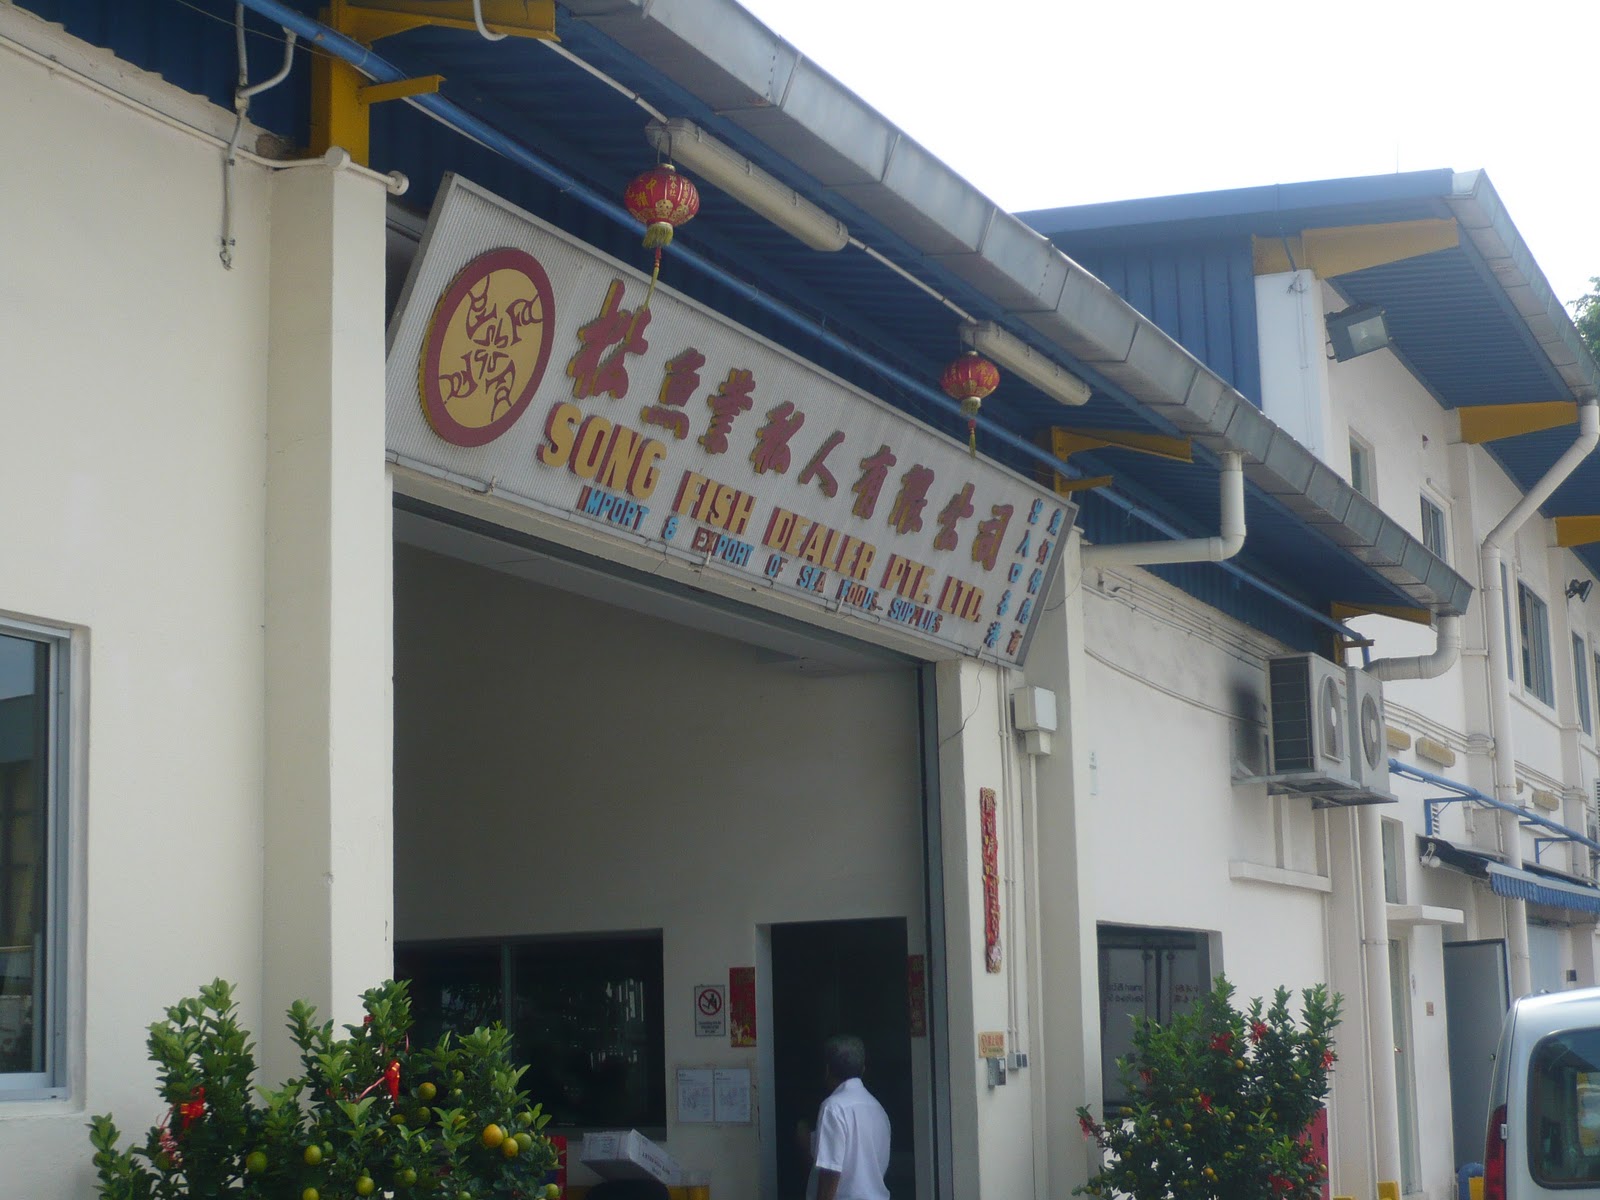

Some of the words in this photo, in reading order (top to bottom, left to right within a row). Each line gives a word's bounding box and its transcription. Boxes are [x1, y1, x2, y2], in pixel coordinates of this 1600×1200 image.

[536, 401, 667, 499] SONG
[672, 470, 757, 536] FISH
[762, 507, 876, 581] DEALER
[881, 553, 935, 604] PTE.
[937, 576, 985, 623] LTD.
[576, 485, 649, 531] IMPORT
[661, 515, 679, 541] &
[691, 526, 754, 567] EXPORT
[765, 553, 788, 578] OF
[797, 565, 827, 593] SEA
[887, 597, 943, 633] SUPPLIES
